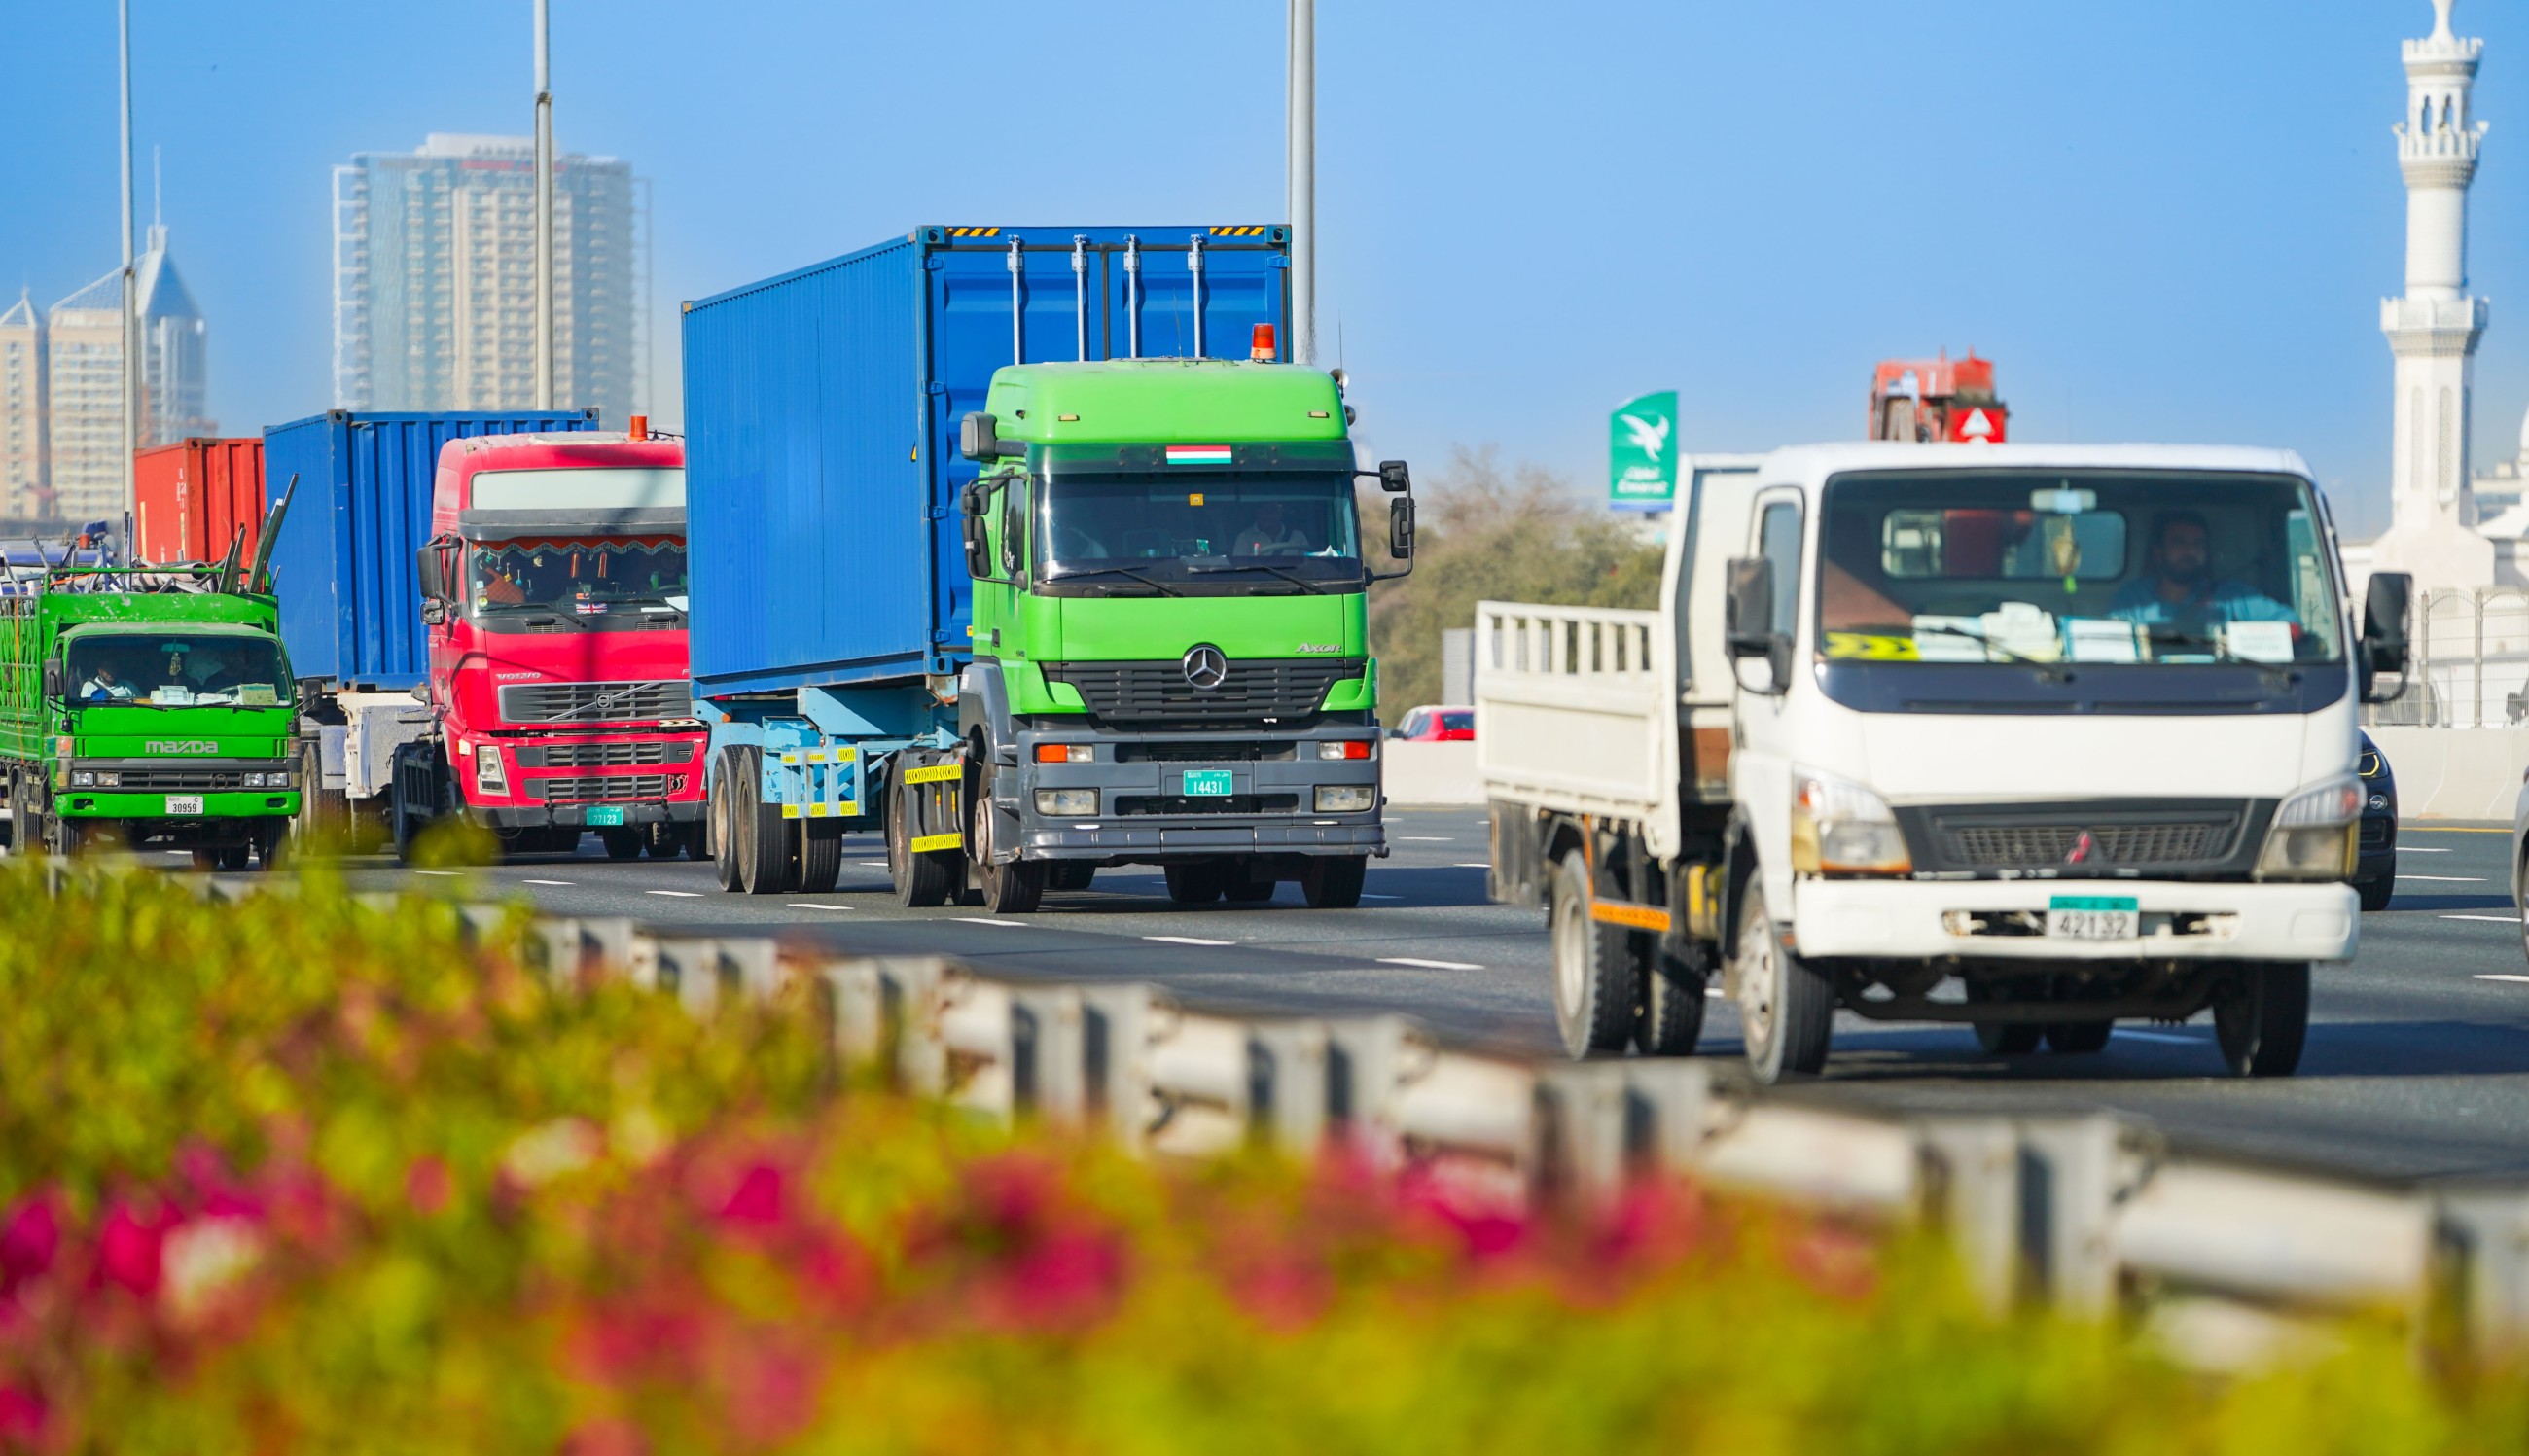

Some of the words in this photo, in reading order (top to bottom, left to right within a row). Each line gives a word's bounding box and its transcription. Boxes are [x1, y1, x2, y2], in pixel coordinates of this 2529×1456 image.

[145, 740, 218, 754] mazda
[1193, 781, 1223, 794] 14431
[172, 803, 197, 813] 30959
[593, 814, 617, 824] 27123
[2059, 912, 2128, 936] 42132
